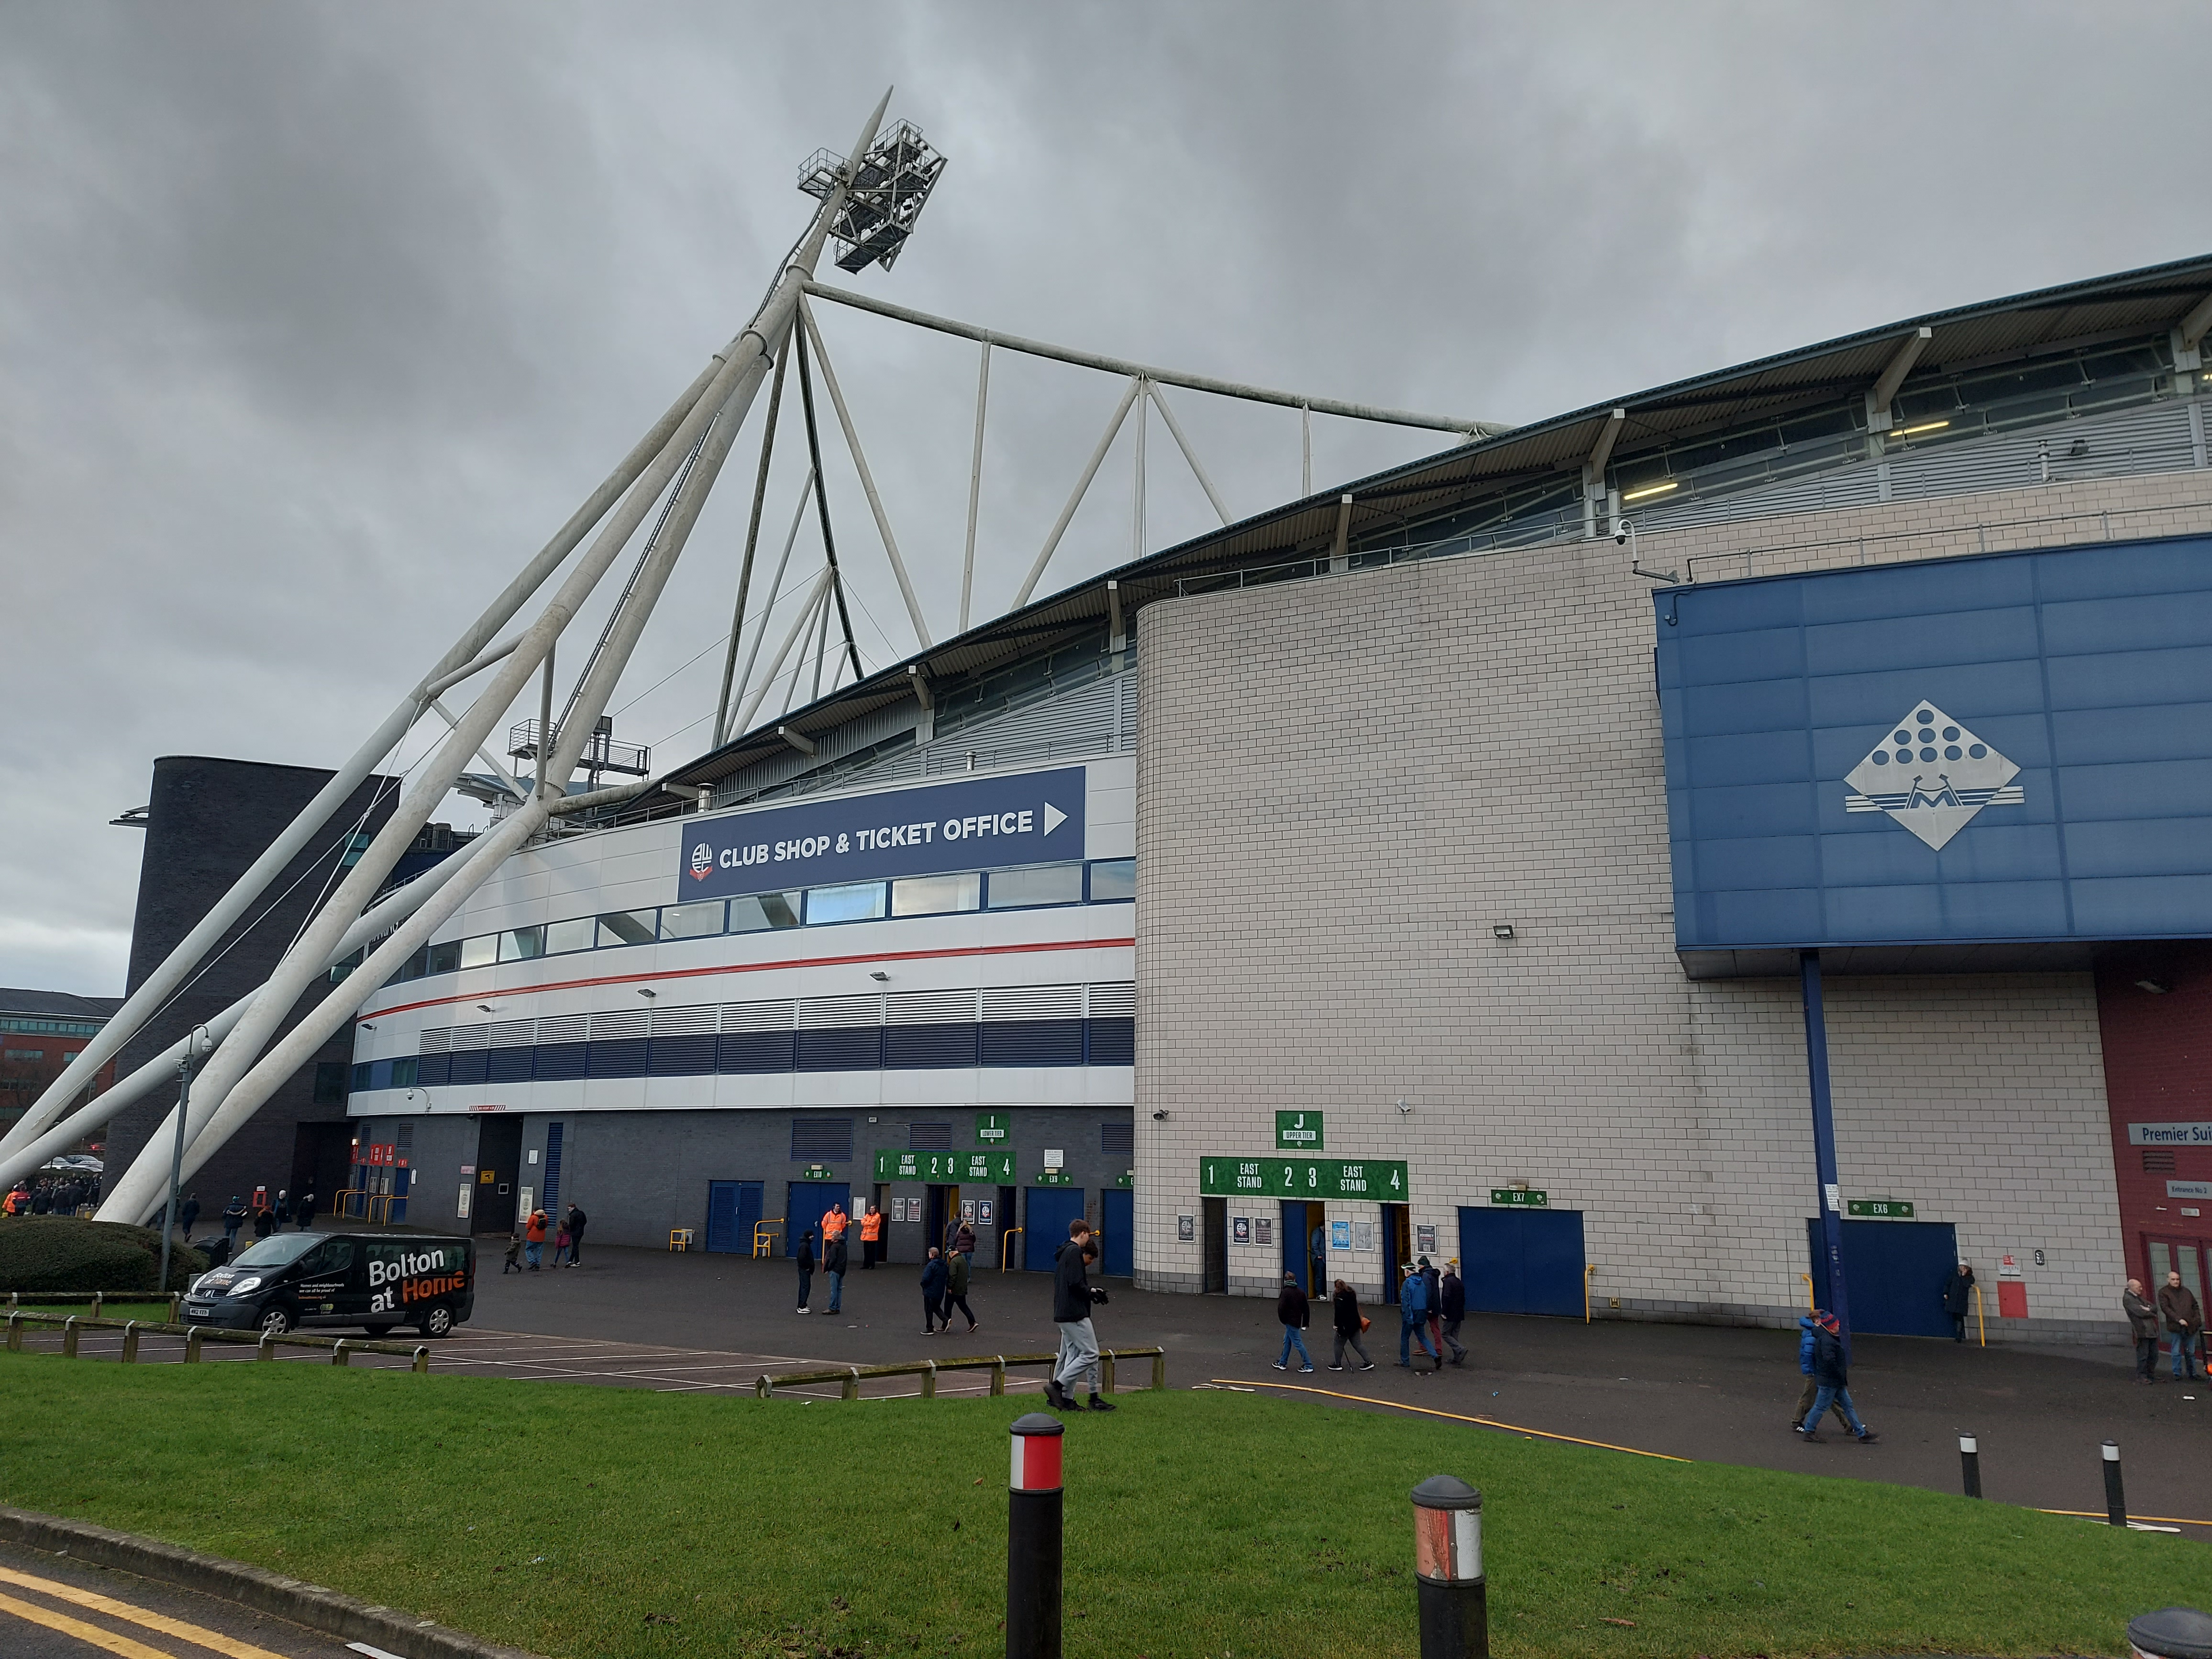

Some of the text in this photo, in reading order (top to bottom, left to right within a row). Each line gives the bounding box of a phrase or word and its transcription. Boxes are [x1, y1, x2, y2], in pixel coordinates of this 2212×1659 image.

[719, 810, 1033, 869] CLUB SHOP & TICKET OFFICE
[1294, 1114, 1304, 1129] J
[2143, 1126, 2212, 1141] Premier Sui
[880, 1156, 884, 1173] 1
[901, 1155, 916, 1165] EAST
[931, 1157, 937, 1174] 2
[948, 1158, 953, 1174] 3
[972, 1156, 986, 1165] EAST
[1003, 1158, 1010, 1175] 4
[899, 1166, 916, 1175] STAND
[969, 1167, 987, 1177] STAND
[1208, 1165, 1214, 1184] 1
[1240, 1163, 1260, 1175] EAST
[1343, 1165, 1363, 1178] EAST
[1049, 1175, 1058, 1183] EX9
[1237, 1176, 1262, 1189] STAND
[1284, 1167, 1293, 1187] 2
[1308, 1167, 1316, 1187] 3
[1390, 1170, 1400, 1190] 4
[1340, 1179, 1367, 1192] STAND
[1513, 1193, 1525, 1202] EX7
[1873, 1204, 1888, 1214] EX6
[369, 1250, 444, 1287] Bolton
[371, 1271, 465, 1313] at Home
